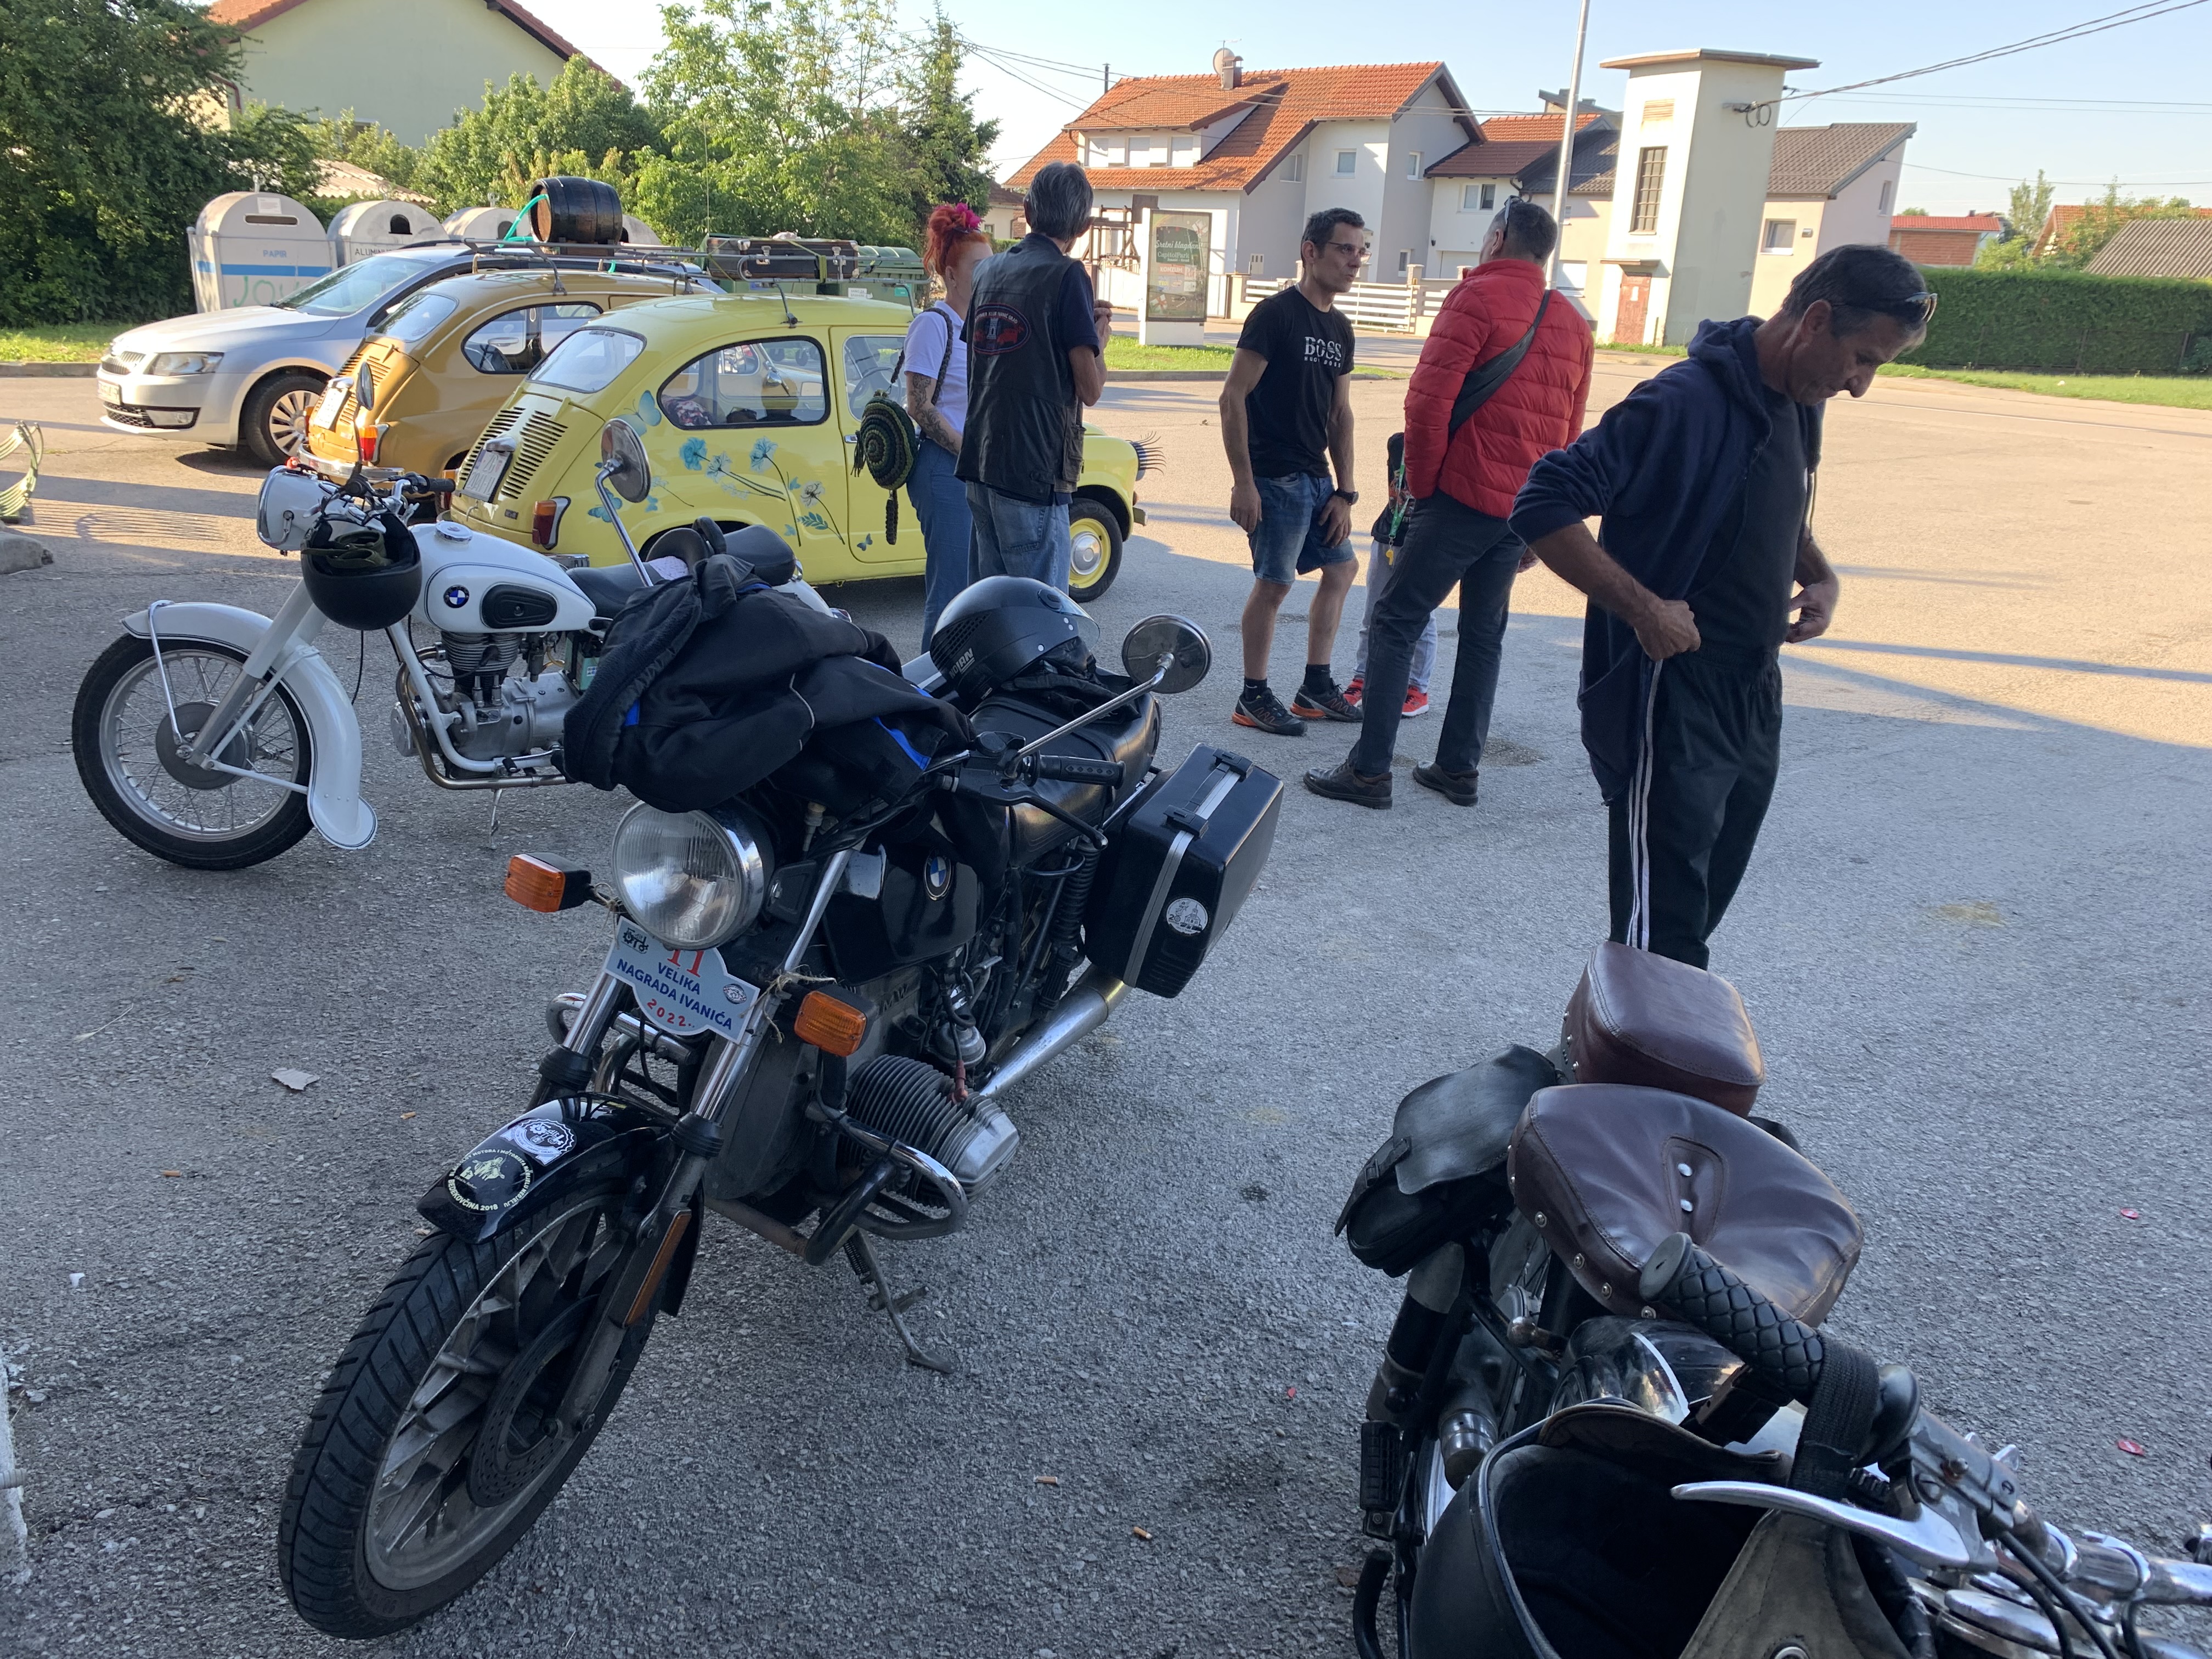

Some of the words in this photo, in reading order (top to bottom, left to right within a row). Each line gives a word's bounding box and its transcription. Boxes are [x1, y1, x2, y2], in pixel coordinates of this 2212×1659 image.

[263, 250, 287, 258] PAPIR
[1305, 336, 1342, 362] BOSS
[949, 647, 974, 680] NOLAN
[658, 962, 701, 995] VELIKA
[617, 958, 677, 1001] NAGRADA
[679, 994, 732, 1030] IVANIĆA
[500, 1149, 527, 1166] MOTORISTA
[448, 1179, 479, 1210] BEDEKOVČINA
[503, 1188, 527, 1207] NEDJELJU
